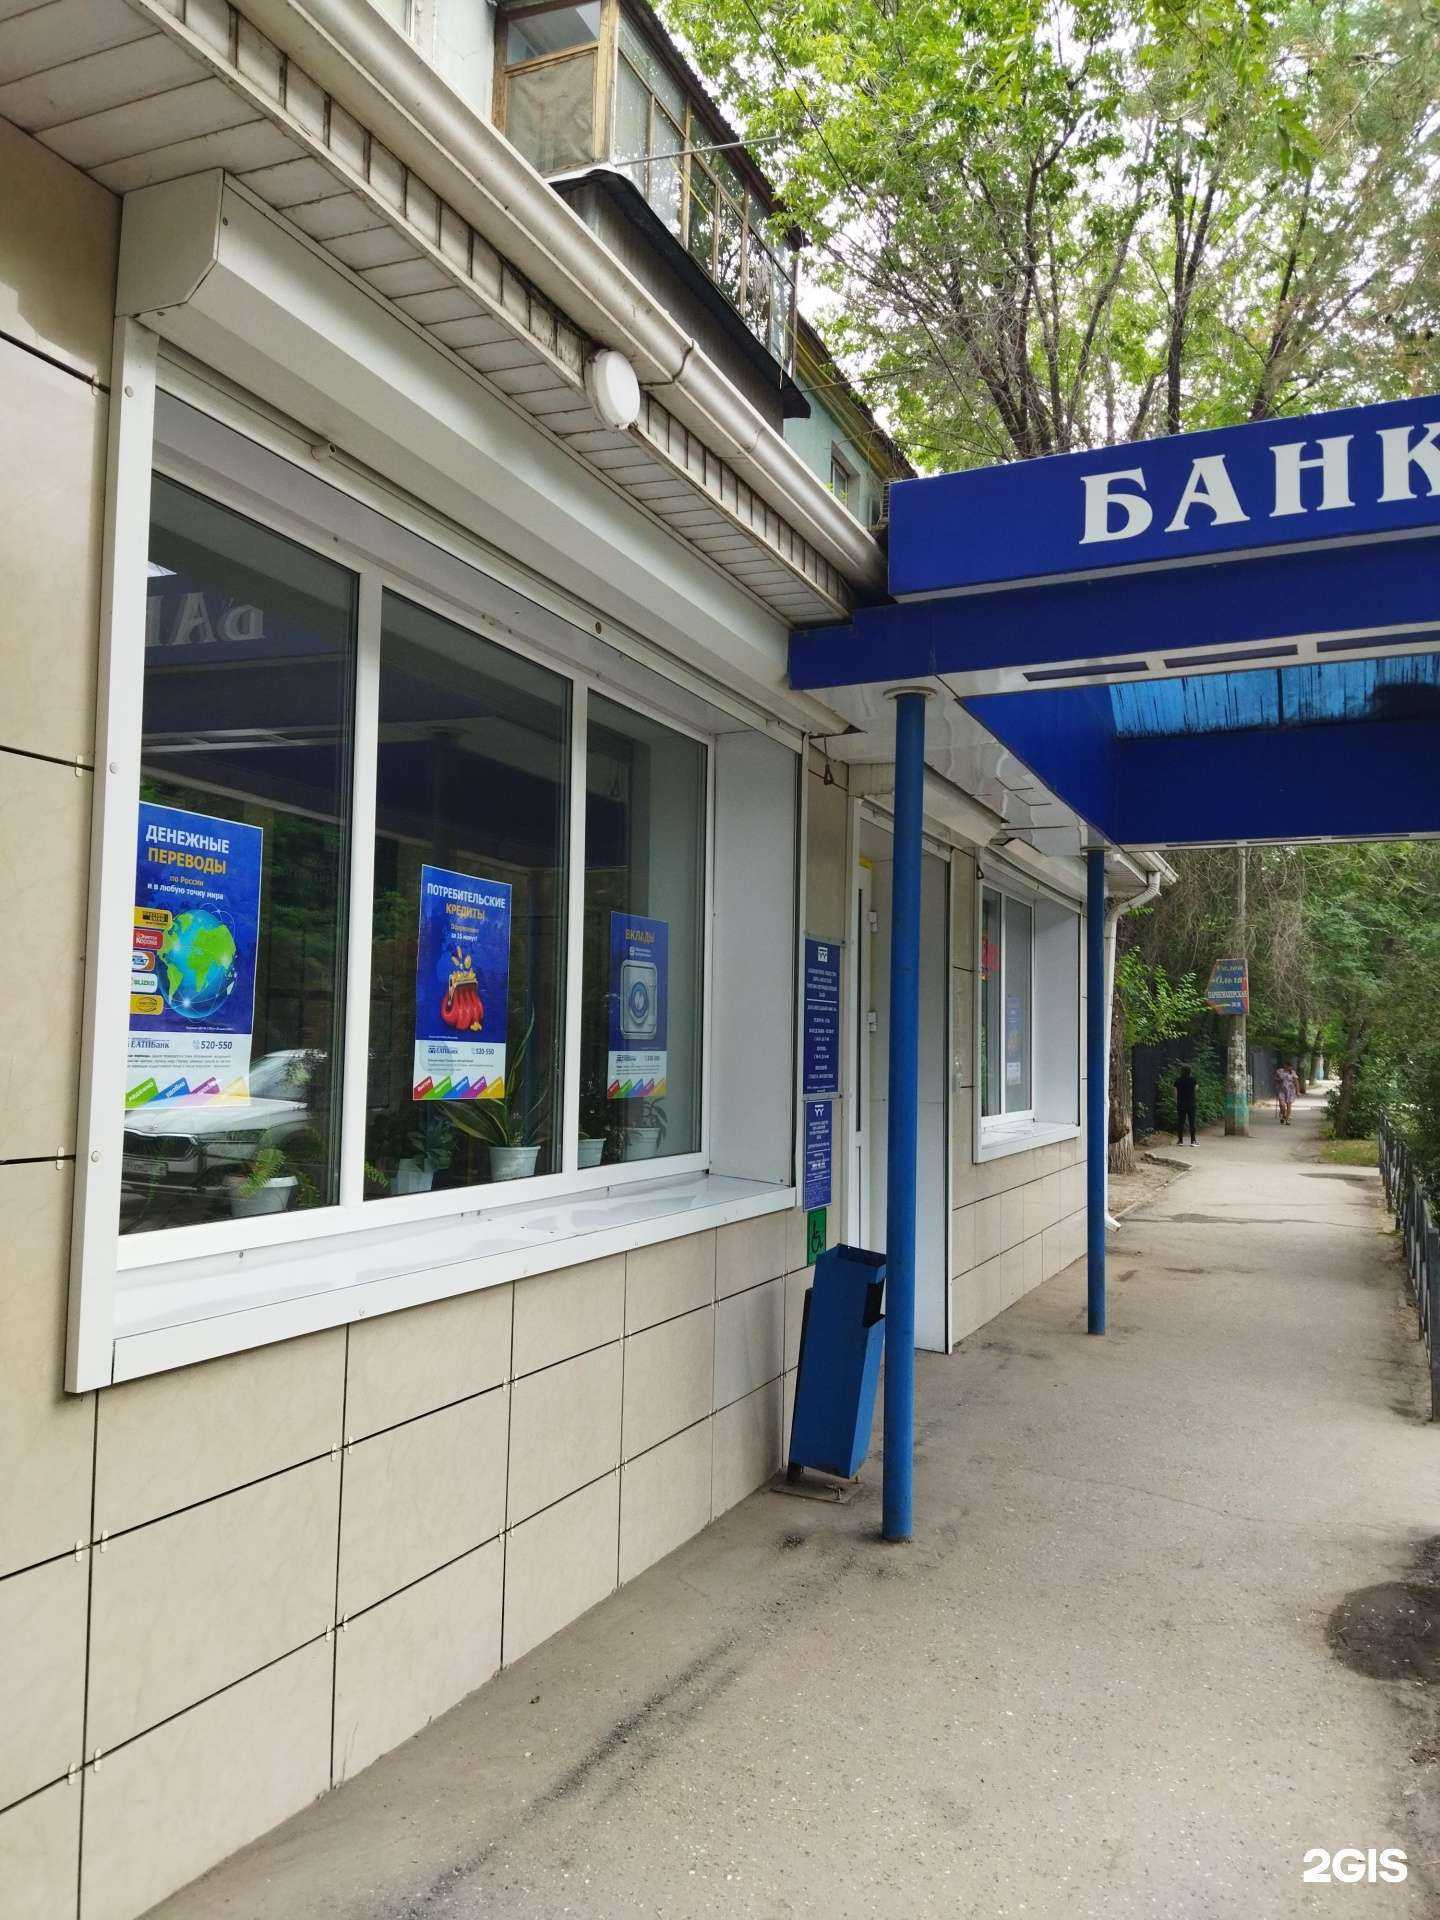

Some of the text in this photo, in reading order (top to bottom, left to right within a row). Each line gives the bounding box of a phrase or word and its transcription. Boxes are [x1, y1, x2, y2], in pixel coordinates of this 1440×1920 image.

[1078, 422, 1440, 545] БАНК
[145, 824, 230, 854] ДЕНЕЖНЫЕ
[148, 847, 226, 875] ПЕРЕВОДЫ
[159, 884, 185, 896] любую
[186, 888, 205, 899] точку
[206, 892, 224, 901] мира
[180, 876, 204, 887] России
[427, 883, 506, 909] ПОТРЕБИТЕЛЬСКИЕ
[446, 903, 485, 921] КРЕДИТЫ
[200, 1040, 233, 1050] 520-550
